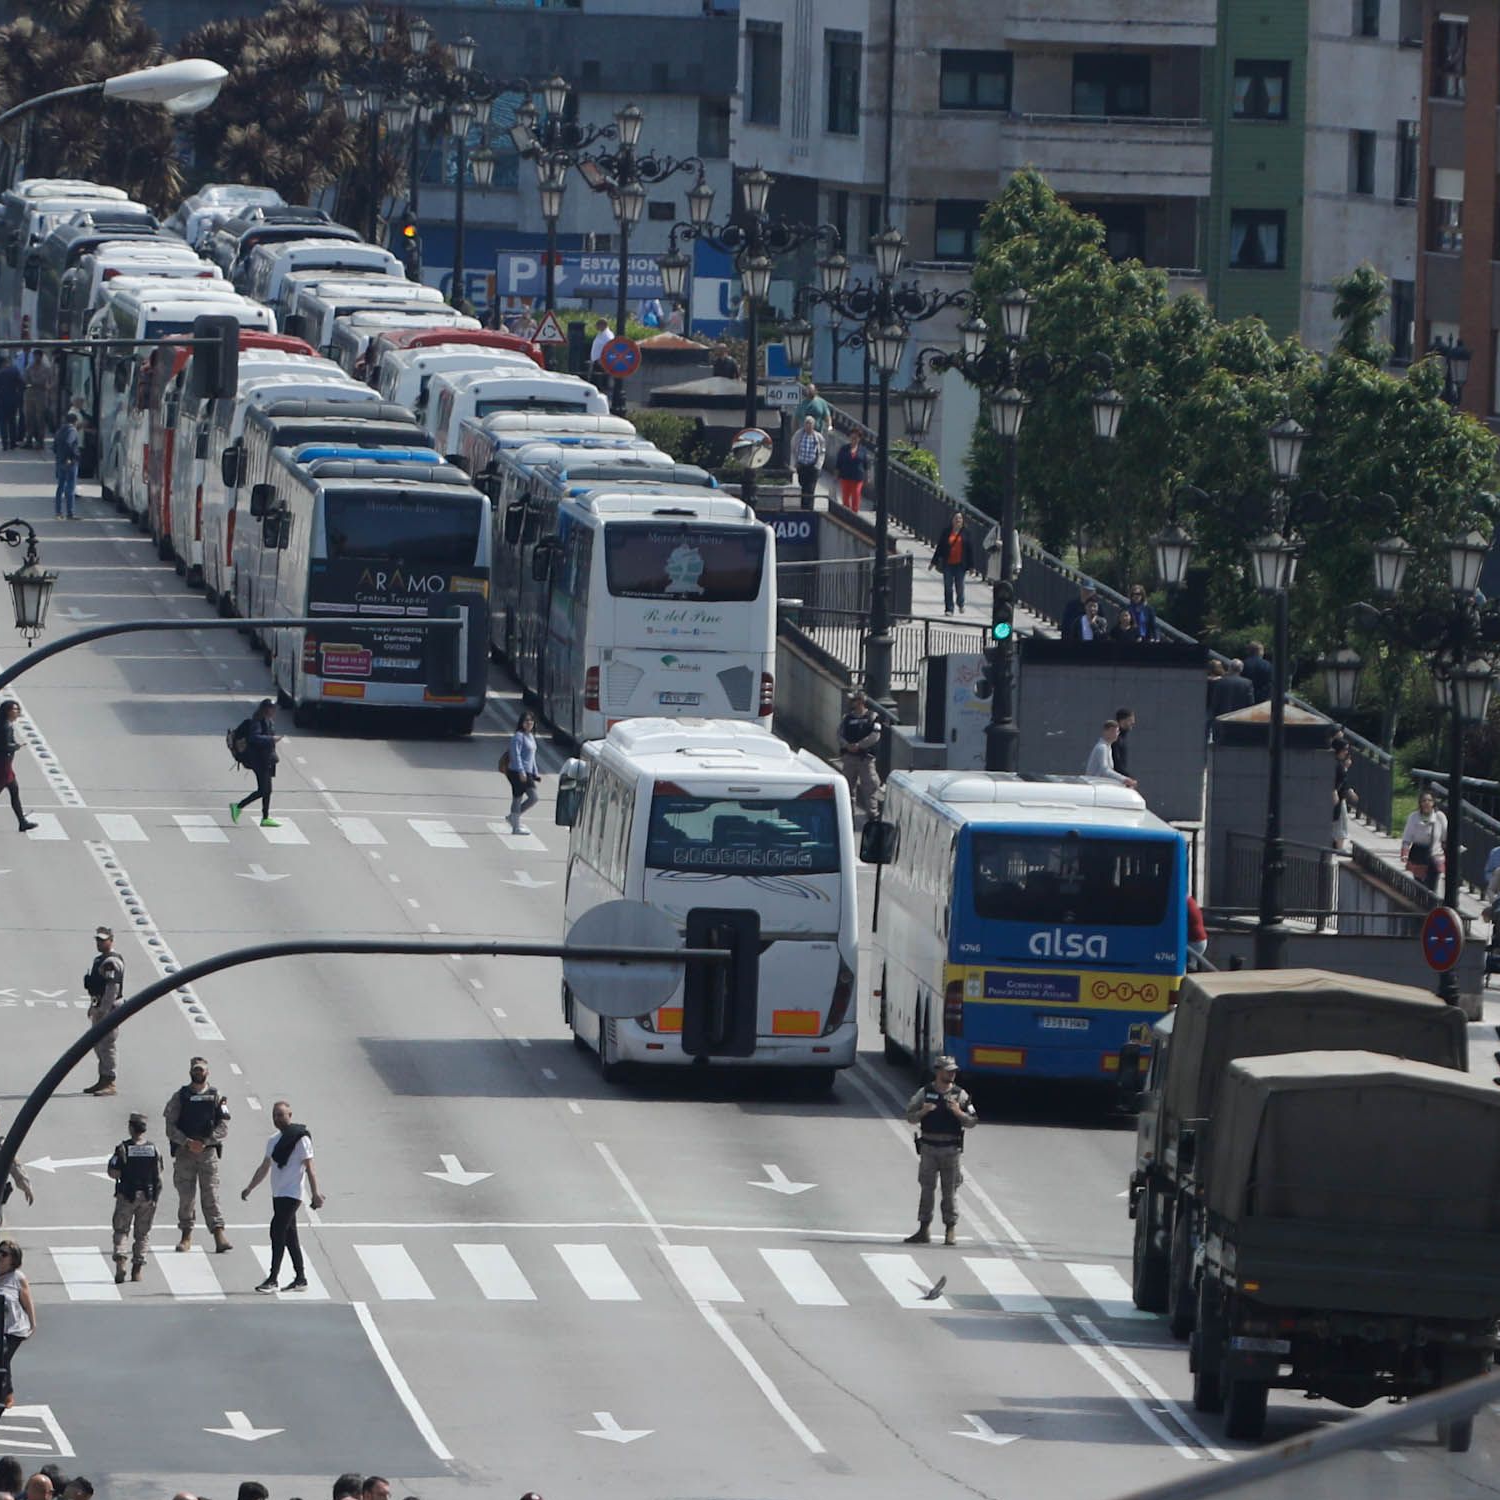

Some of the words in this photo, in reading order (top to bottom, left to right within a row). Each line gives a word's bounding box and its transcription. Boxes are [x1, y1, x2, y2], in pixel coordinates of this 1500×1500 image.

[508, 257, 538, 292] P
[580, 257, 660, 270] ESTAION
[768, 390, 783, 400] 40
[1028, 928, 1108, 959] alsa
